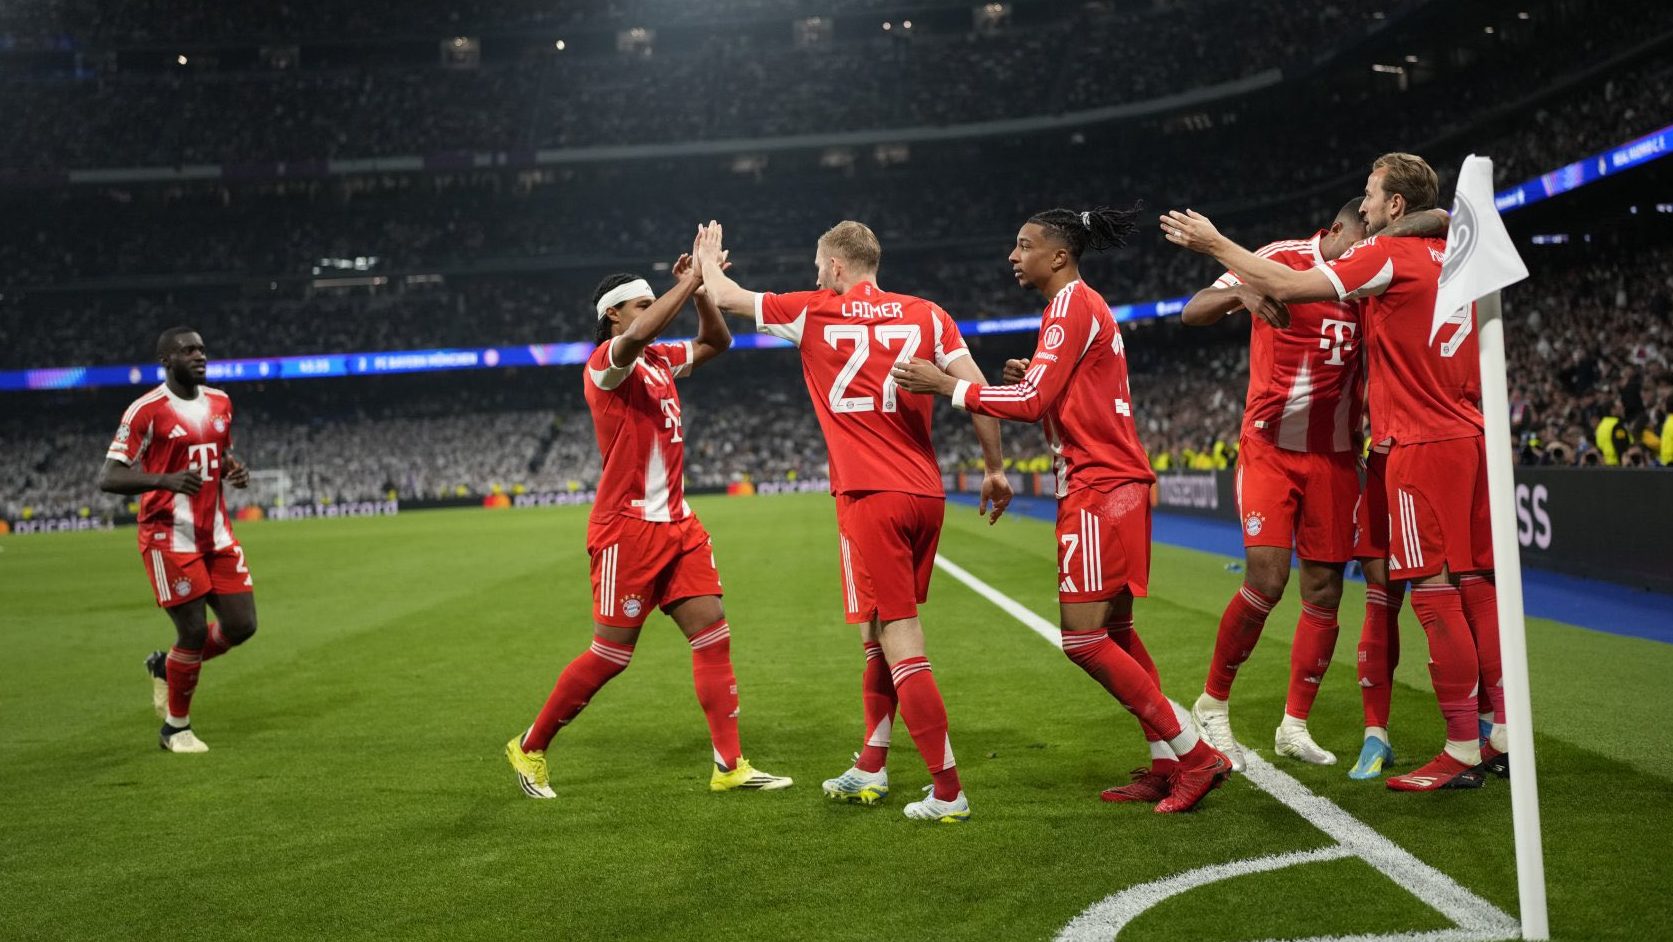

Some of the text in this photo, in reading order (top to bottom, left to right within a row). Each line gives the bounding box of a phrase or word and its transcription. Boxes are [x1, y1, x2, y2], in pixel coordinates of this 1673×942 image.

[842, 301, 903, 319] LAIMER
[824, 324, 922, 413] 27
[14, 514, 101, 535] priceles
[1061, 533, 1079, 574] 7
